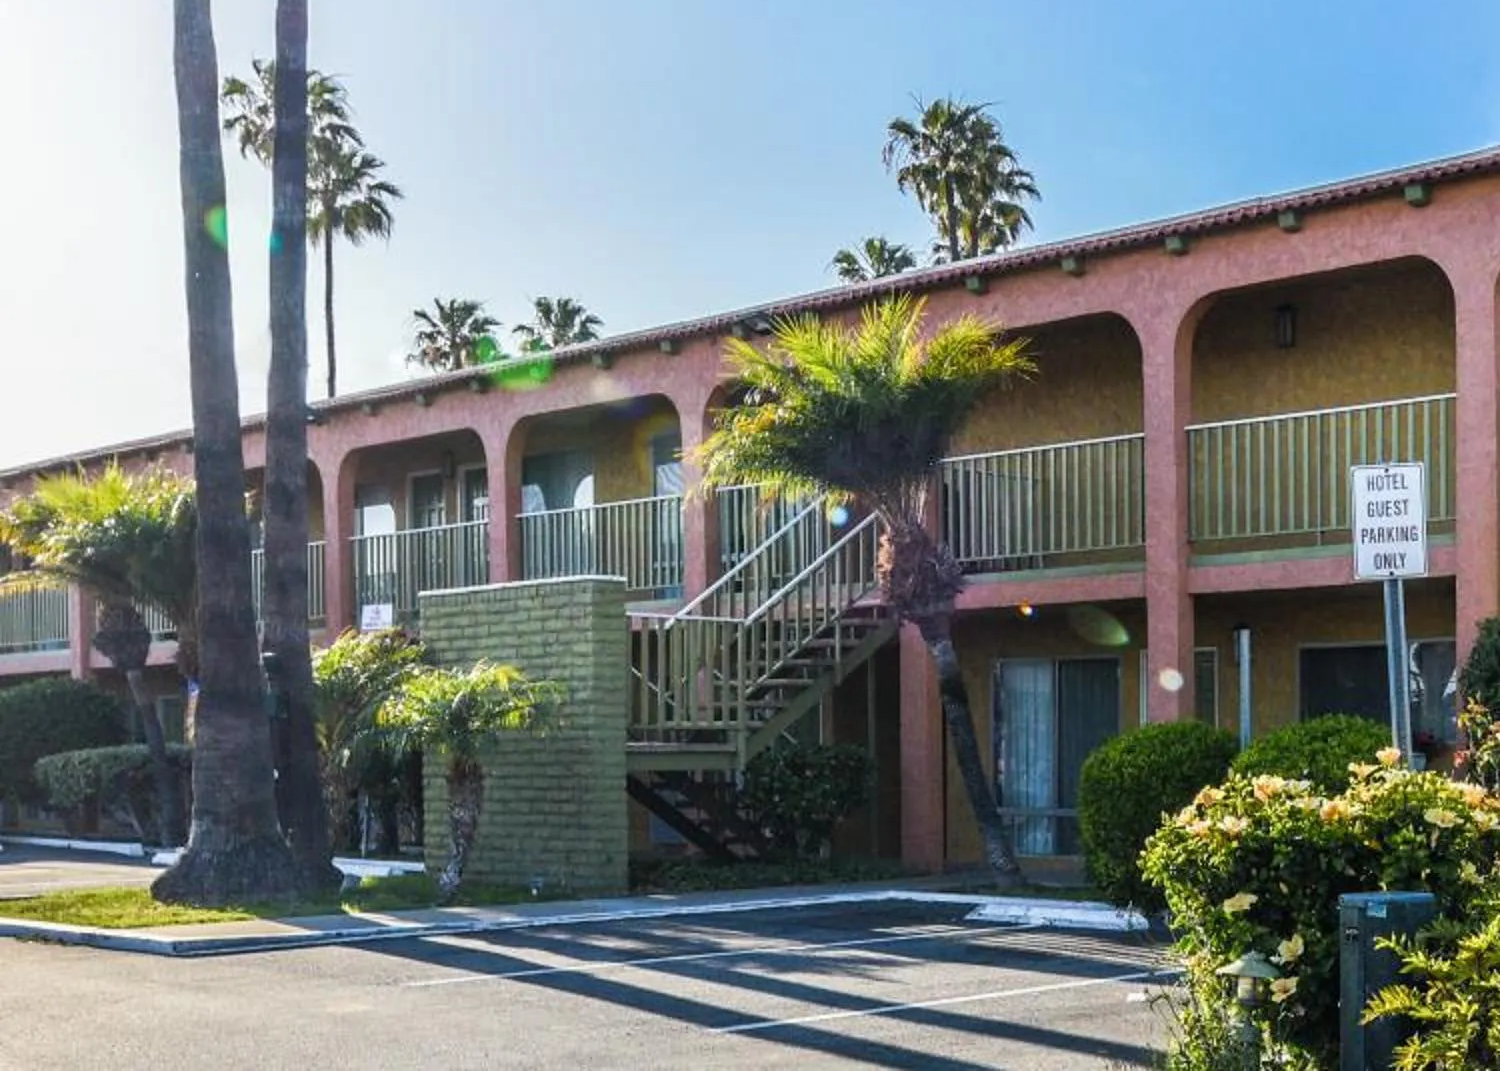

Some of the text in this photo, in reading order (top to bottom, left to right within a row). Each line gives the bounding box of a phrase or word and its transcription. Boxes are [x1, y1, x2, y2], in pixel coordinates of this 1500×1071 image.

[1367, 473, 1409, 491] HOTEL
[1367, 499, 1409, 517] GUEST
[1361, 526, 1419, 545] PARKING
[1373, 553, 1408, 570] ONLY
